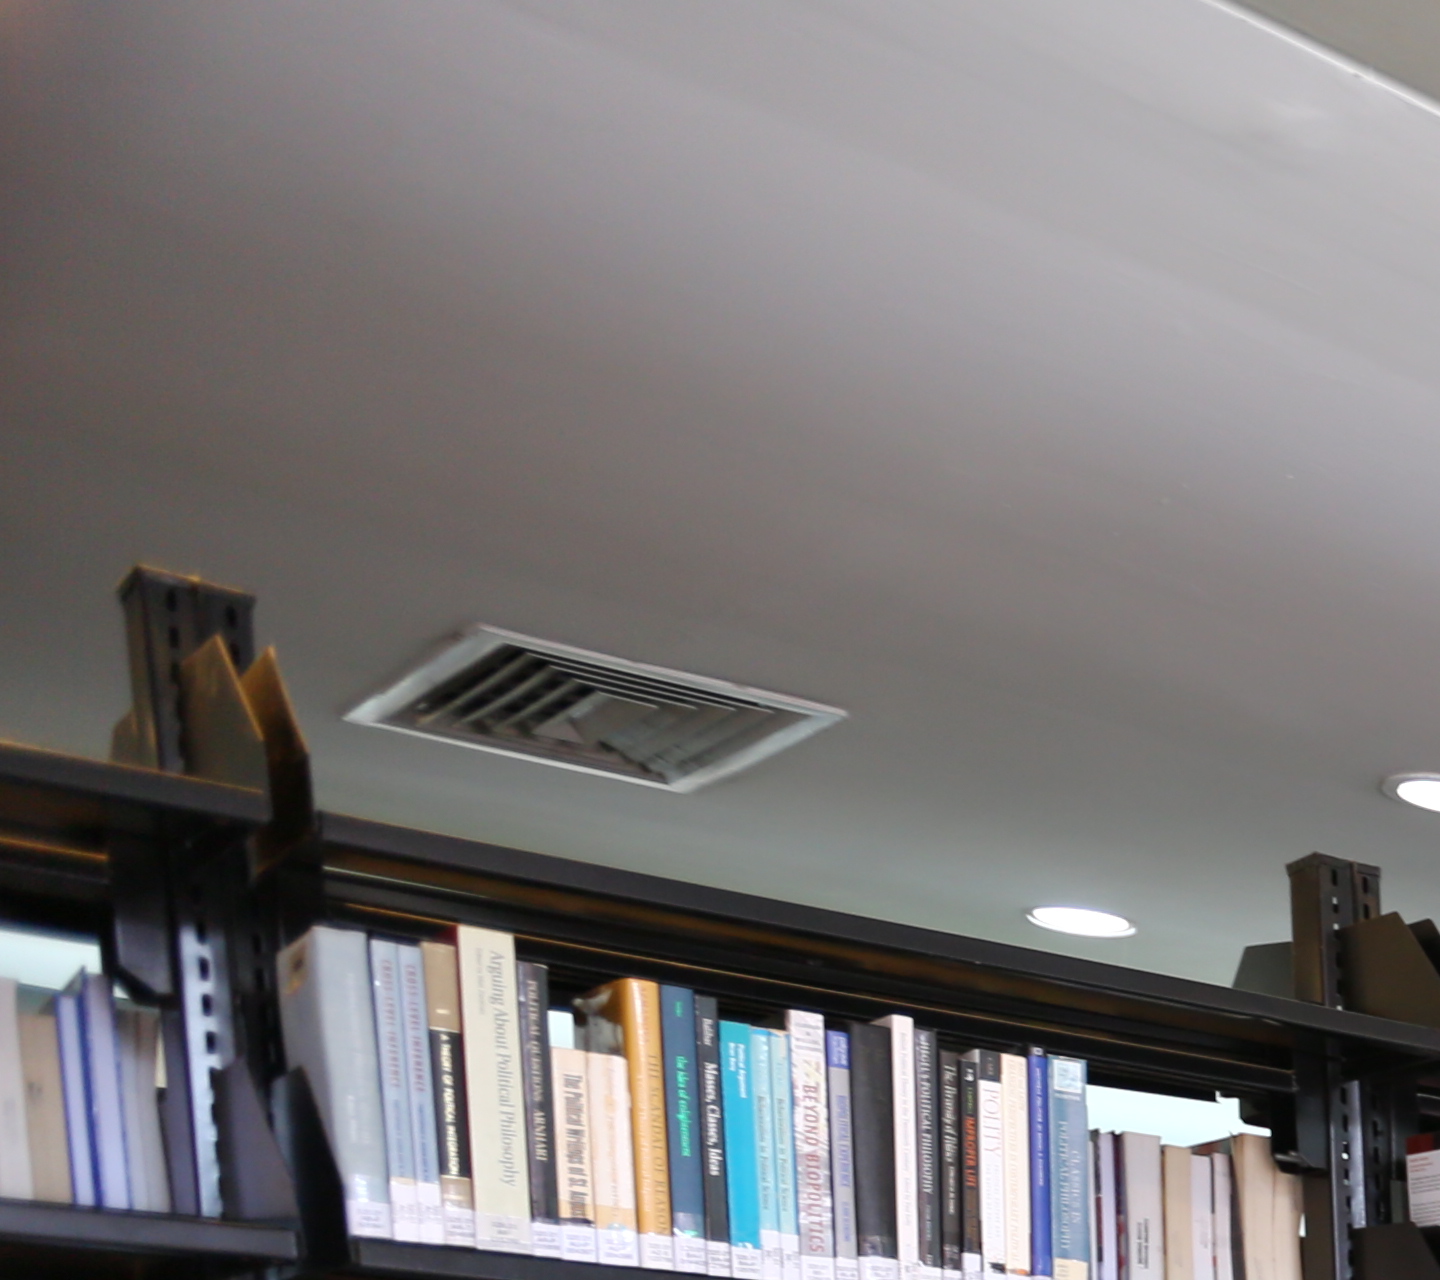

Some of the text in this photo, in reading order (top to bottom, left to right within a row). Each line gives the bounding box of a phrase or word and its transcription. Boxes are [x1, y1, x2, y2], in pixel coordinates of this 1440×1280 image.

[487, 951, 519, 1186] Arguing About Political Philosophy
[704, 1062, 723, 1176] Masses, Classes, Ideas
[921, 1081, 932, 1130] POLITICAL
[802, 1084, 825, 1253] BEYOND BIOPOLITICS
[922, 1133, 933, 1195] PHILOSOPHY
